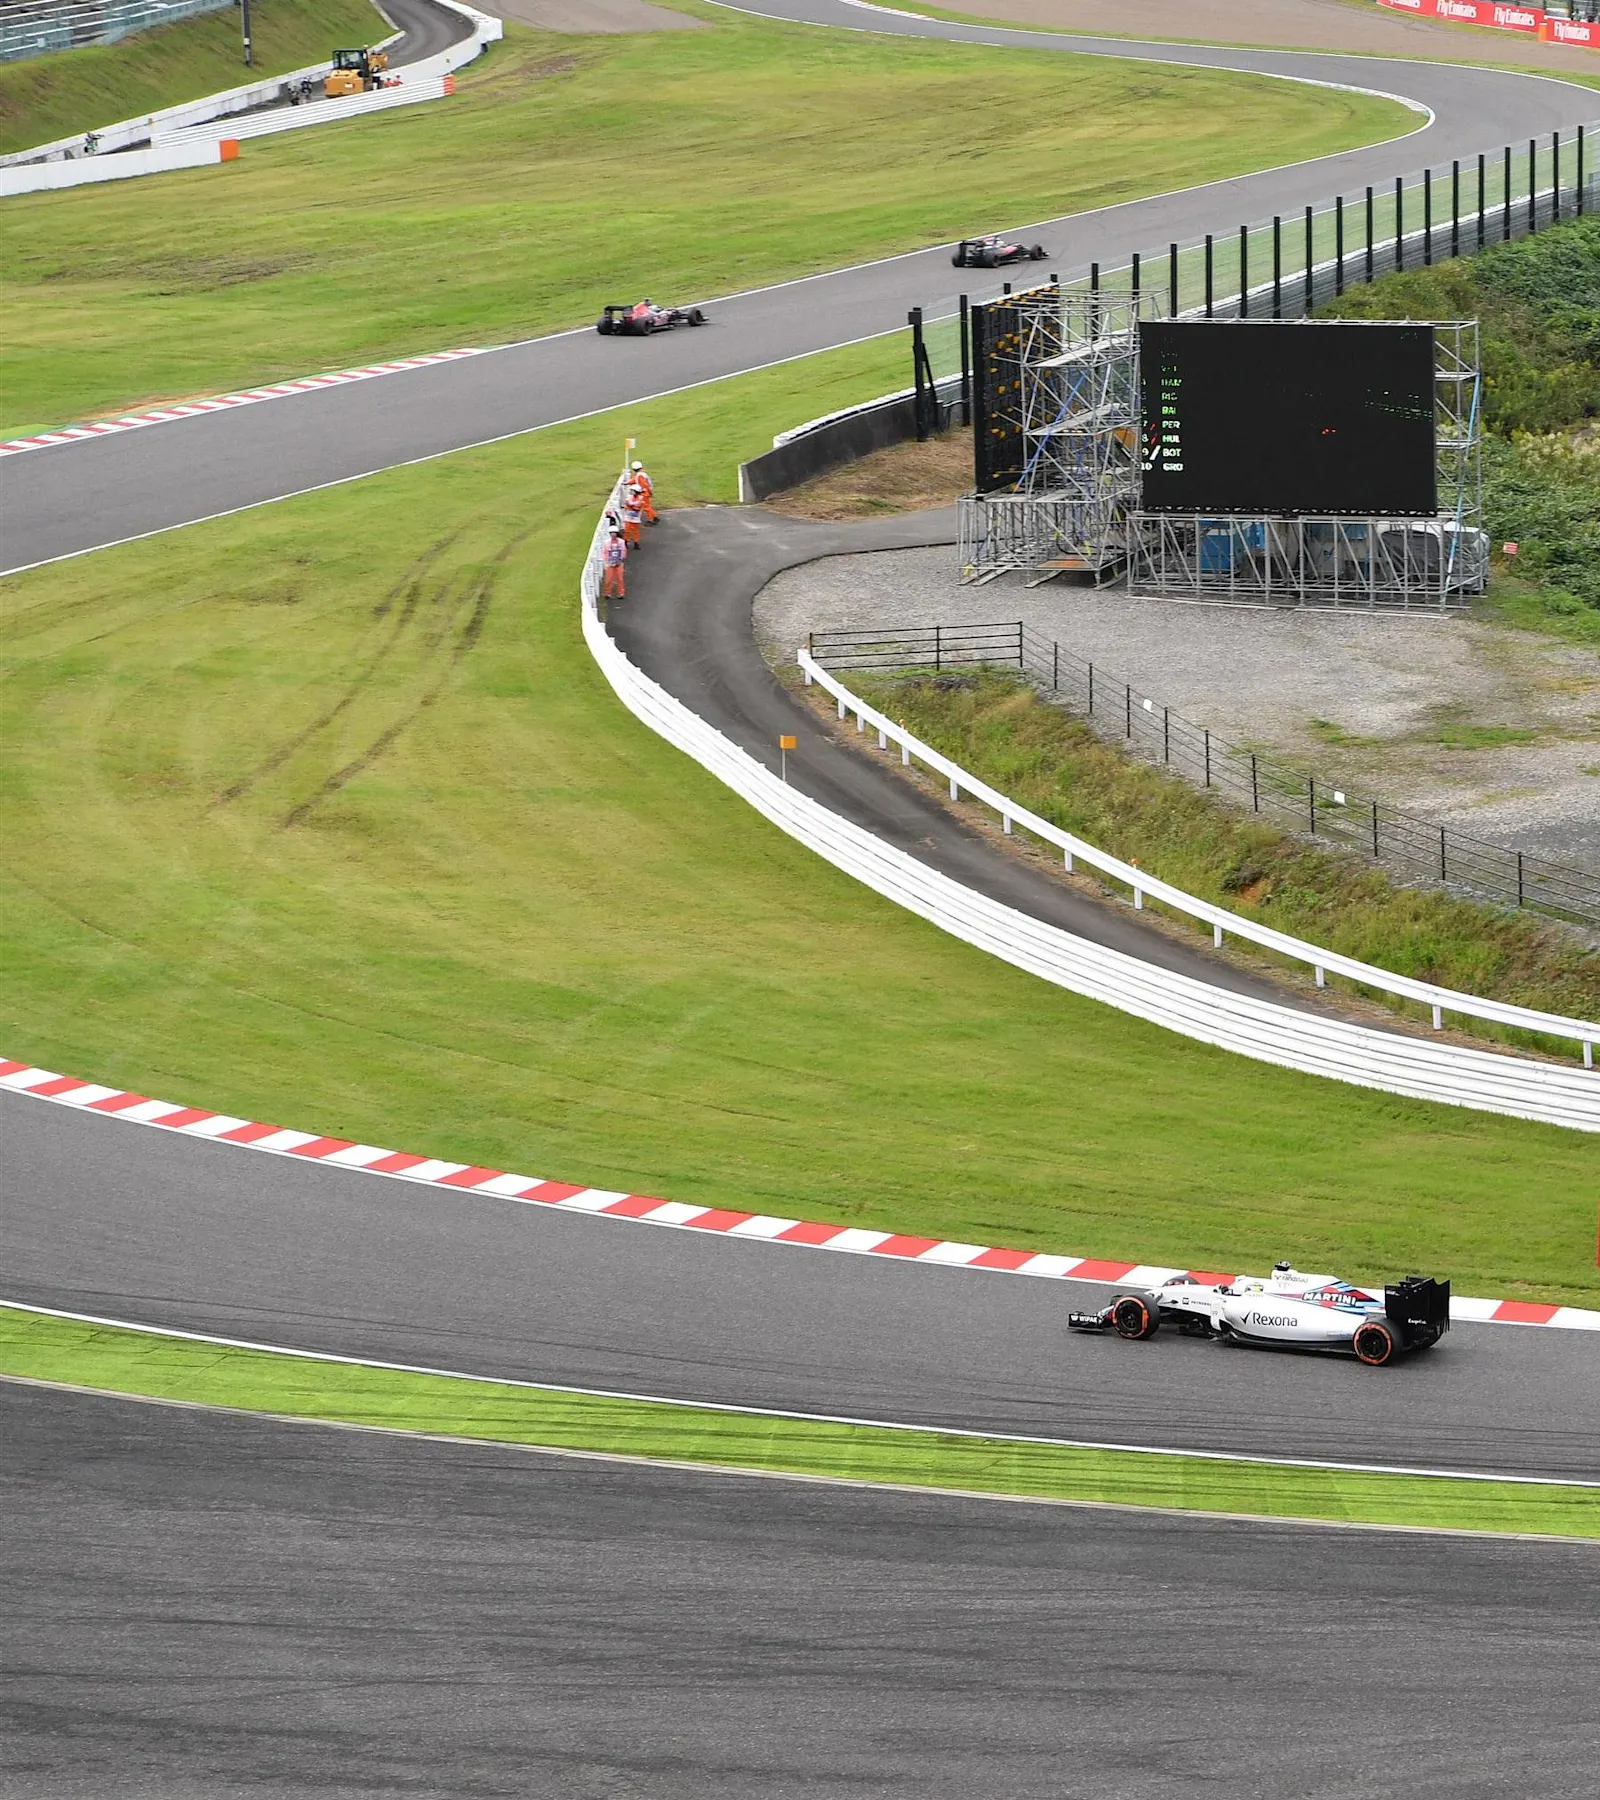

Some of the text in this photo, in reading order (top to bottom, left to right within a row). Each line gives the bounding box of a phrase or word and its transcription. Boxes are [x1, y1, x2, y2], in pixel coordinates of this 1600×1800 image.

[1494, 6, 1505, 26] Fly
[1163, 435, 1180, 443] HUL
[1142, 448, 1182, 457] 9 BOT
[1163, 463, 1183, 471] GRO
[1302, 1291, 1357, 1306] MARTINI
[1252, 1312, 1298, 1327] Rexona
